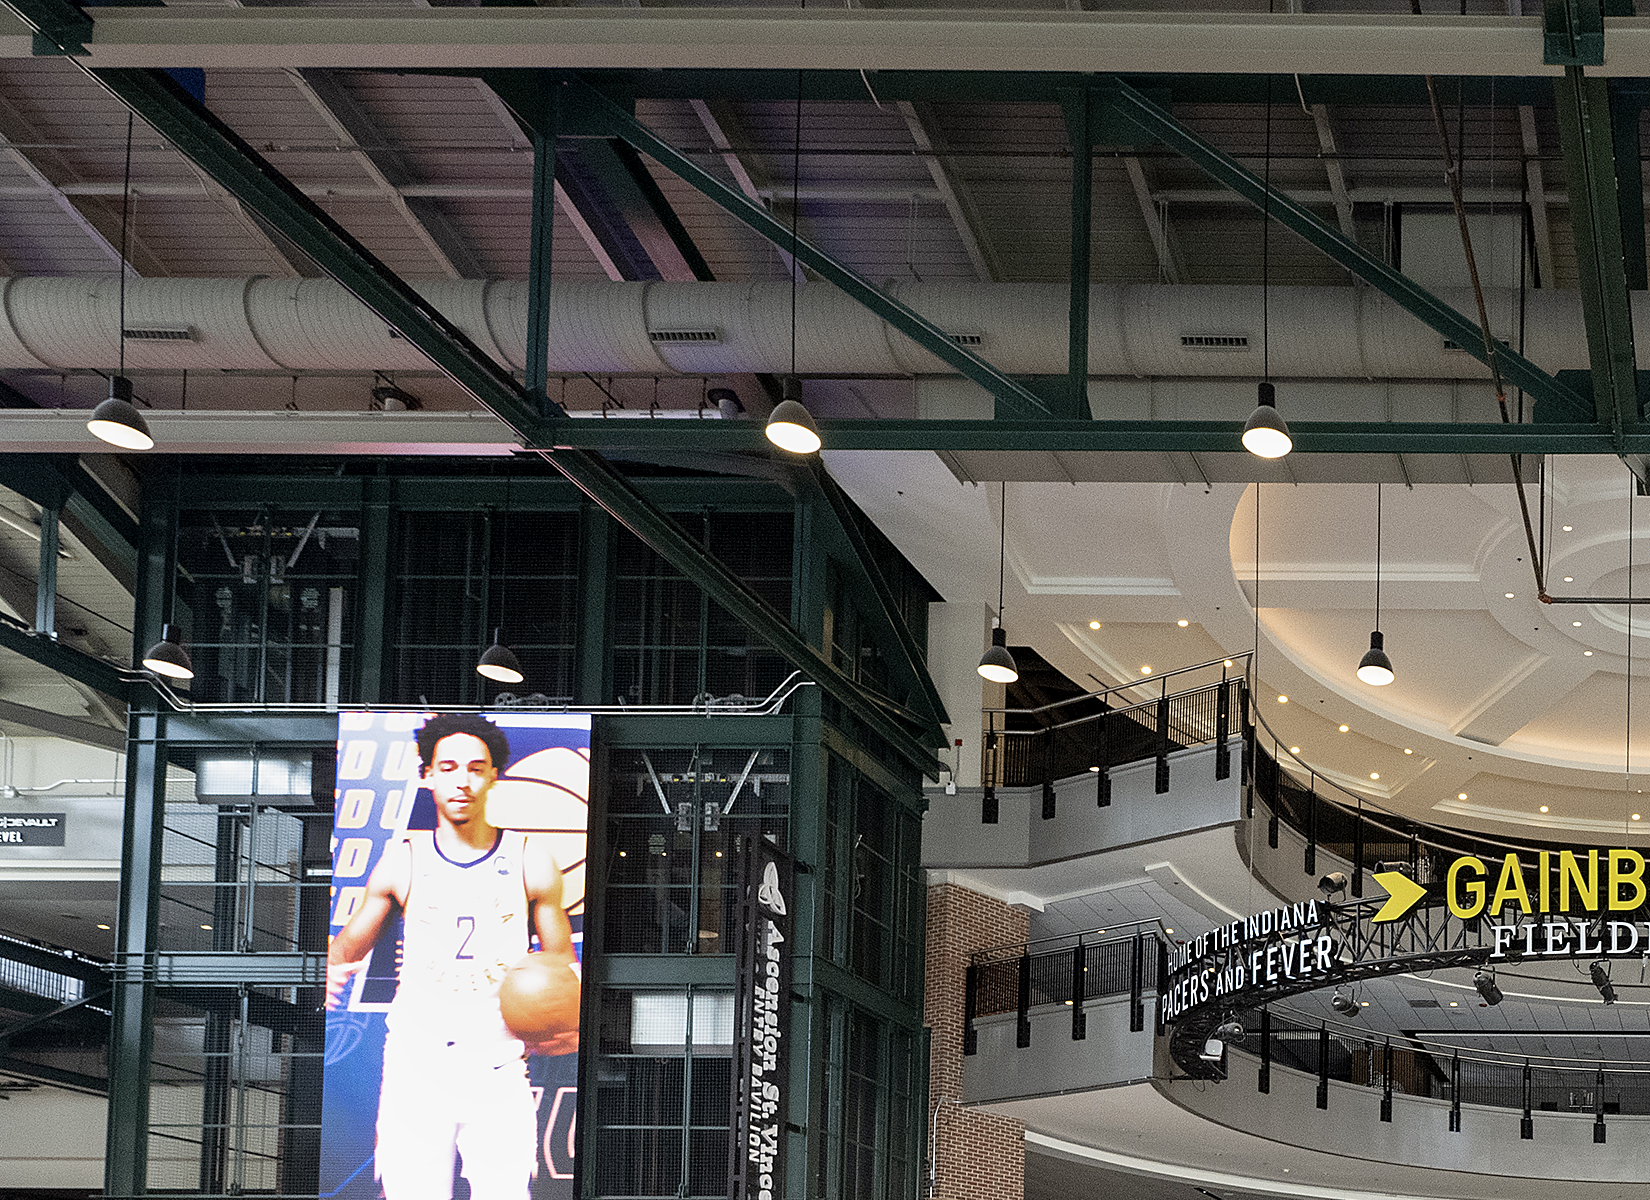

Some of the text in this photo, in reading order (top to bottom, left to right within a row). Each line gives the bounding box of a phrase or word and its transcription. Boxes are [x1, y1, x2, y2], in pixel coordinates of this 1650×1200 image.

[456, 916, 475, 960] 2
[1168, 899, 1318, 976] HOME OF THE INDIANA
[763, 920, 784, 1072] Ascension
[1161, 935, 1332, 1024] PACERS AND FEVER
[762, 1082, 779, 1119] St.
